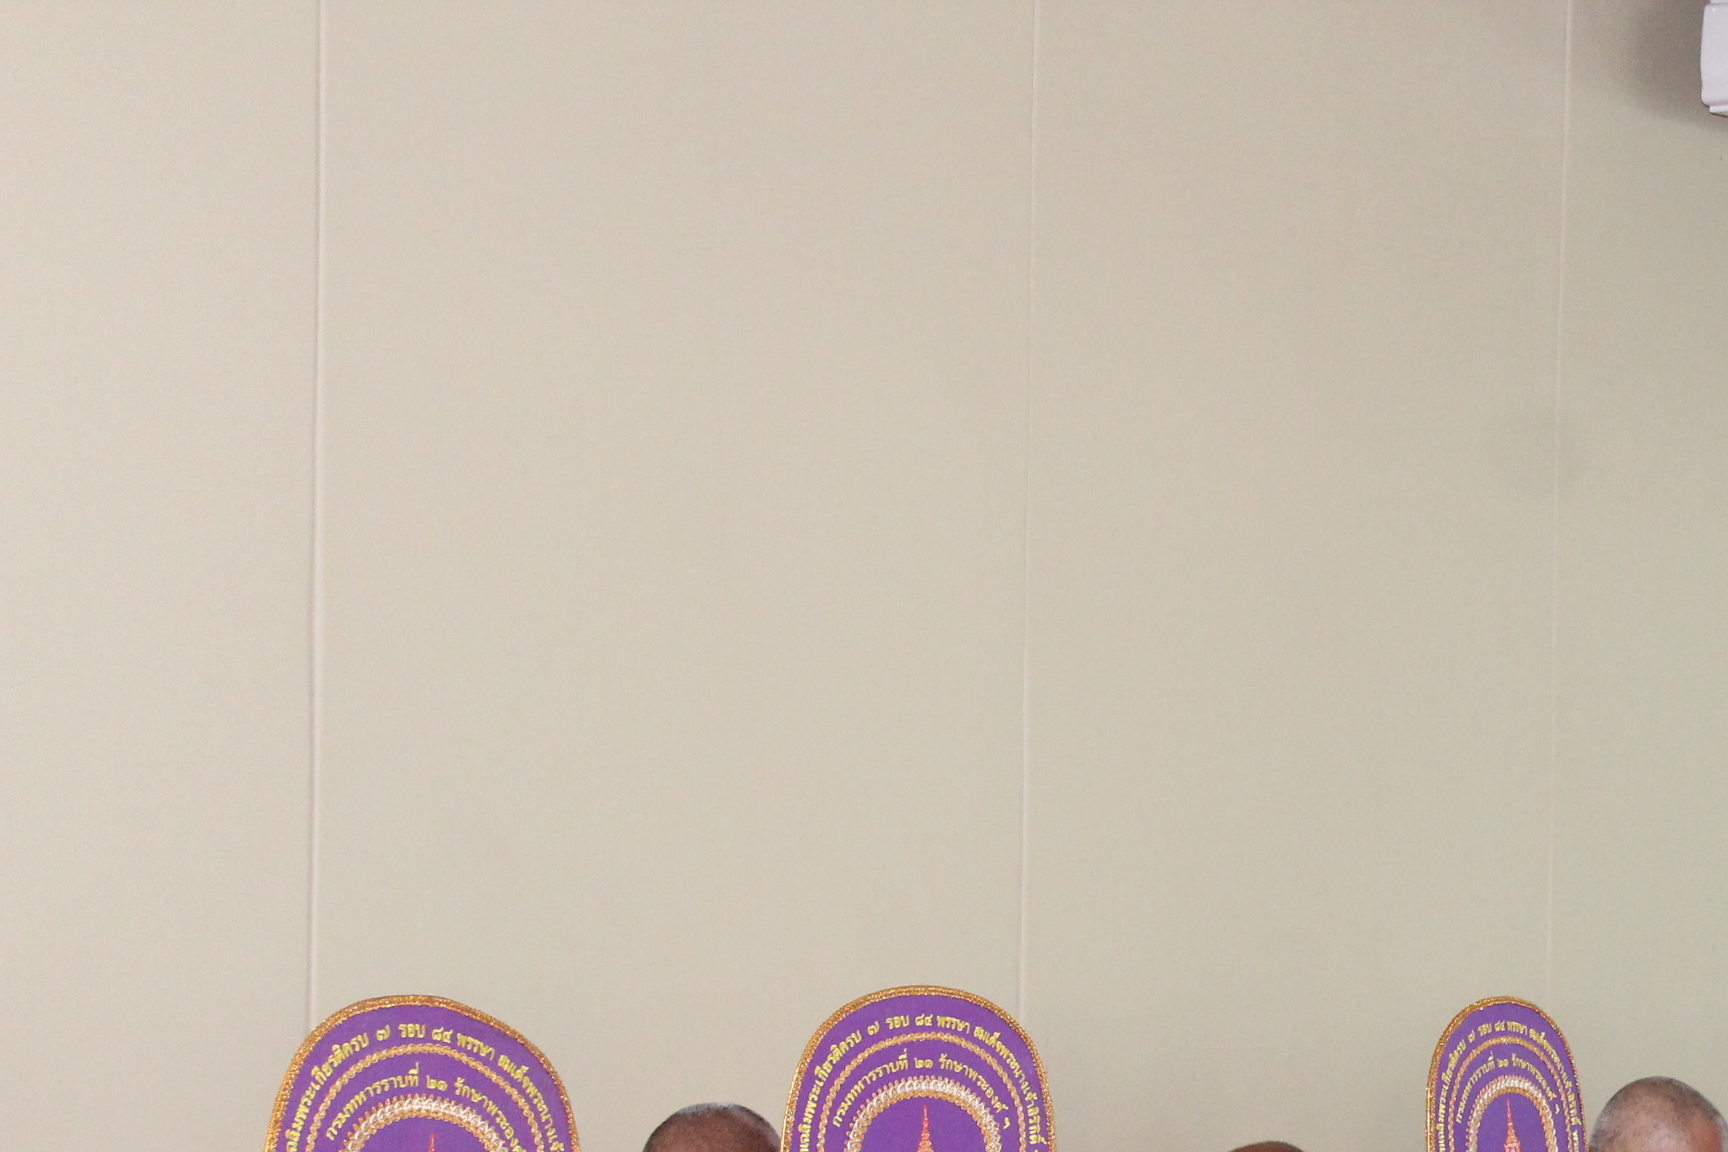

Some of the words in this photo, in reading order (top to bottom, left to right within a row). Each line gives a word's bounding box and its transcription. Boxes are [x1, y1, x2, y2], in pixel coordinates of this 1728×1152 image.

[376, 1025, 391, 1041] ๗
[398, 1023, 426, 1038] รอบ
[432, 1027, 453, 1043] ๘๔
[457, 1033, 496, 1060] พรรษา
[867, 1021, 880, 1035] ๗
[886, 1014, 910, 1029] รอบ
[915, 1014, 933, 1026] ๘๔
[937, 1015, 970, 1034] พรรษา
[326, 1061, 420, 1141] กรมทหารราบที่
[426, 1075, 448, 1091] ๒๑
[832, 1048, 908, 1128] กรมทหารราบที่
[914, 1057, 933, 1069] ๒๑
[938, 1053, 1008, 1113] รักษาพระองค์
